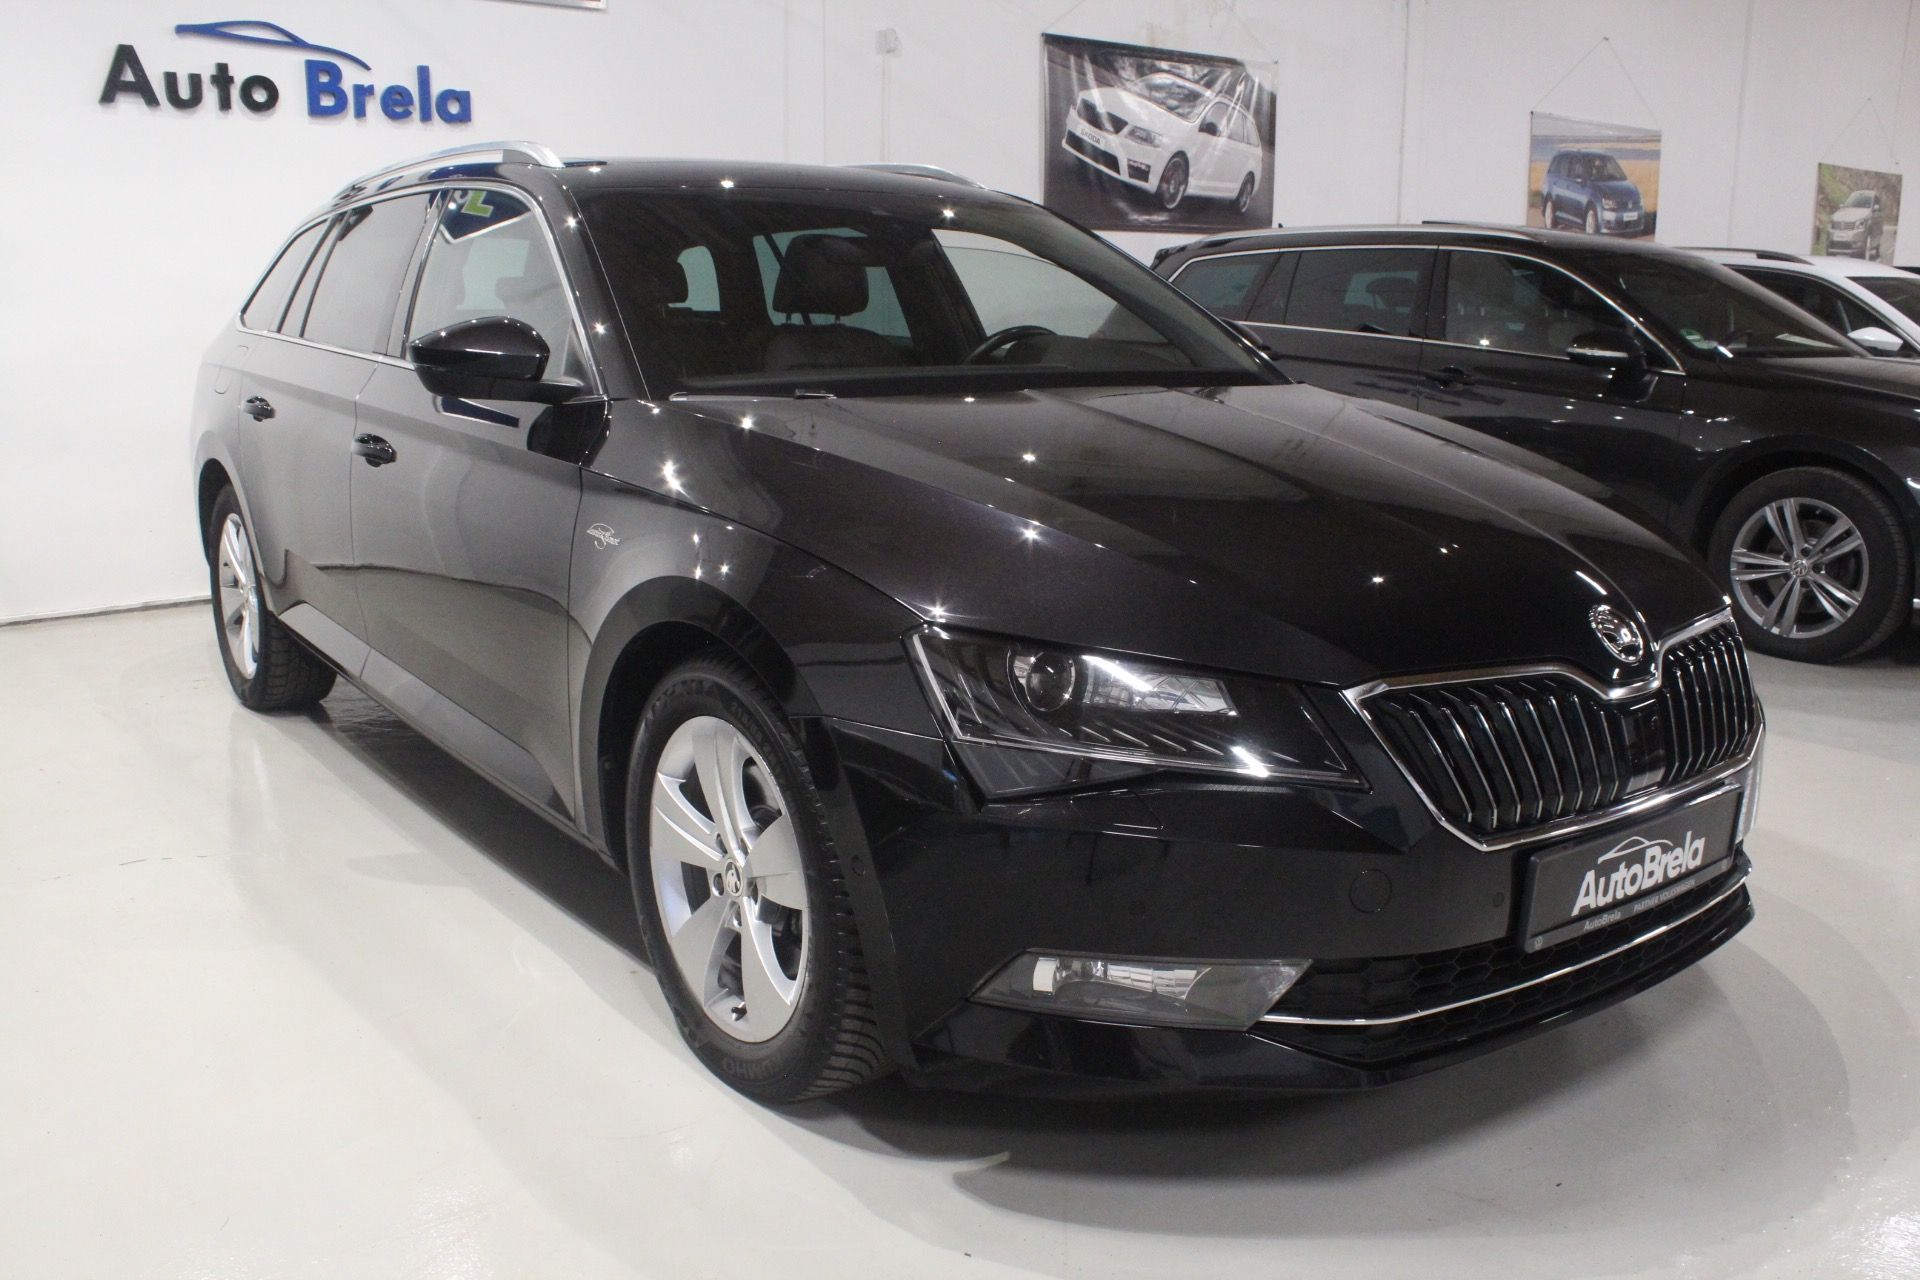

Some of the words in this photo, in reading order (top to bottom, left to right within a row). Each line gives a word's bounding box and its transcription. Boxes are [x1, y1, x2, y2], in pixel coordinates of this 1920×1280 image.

[99, 44, 279, 113] Auto
[305, 59, 472, 123] Brela
[1571, 831, 1705, 917] AutoBrela
